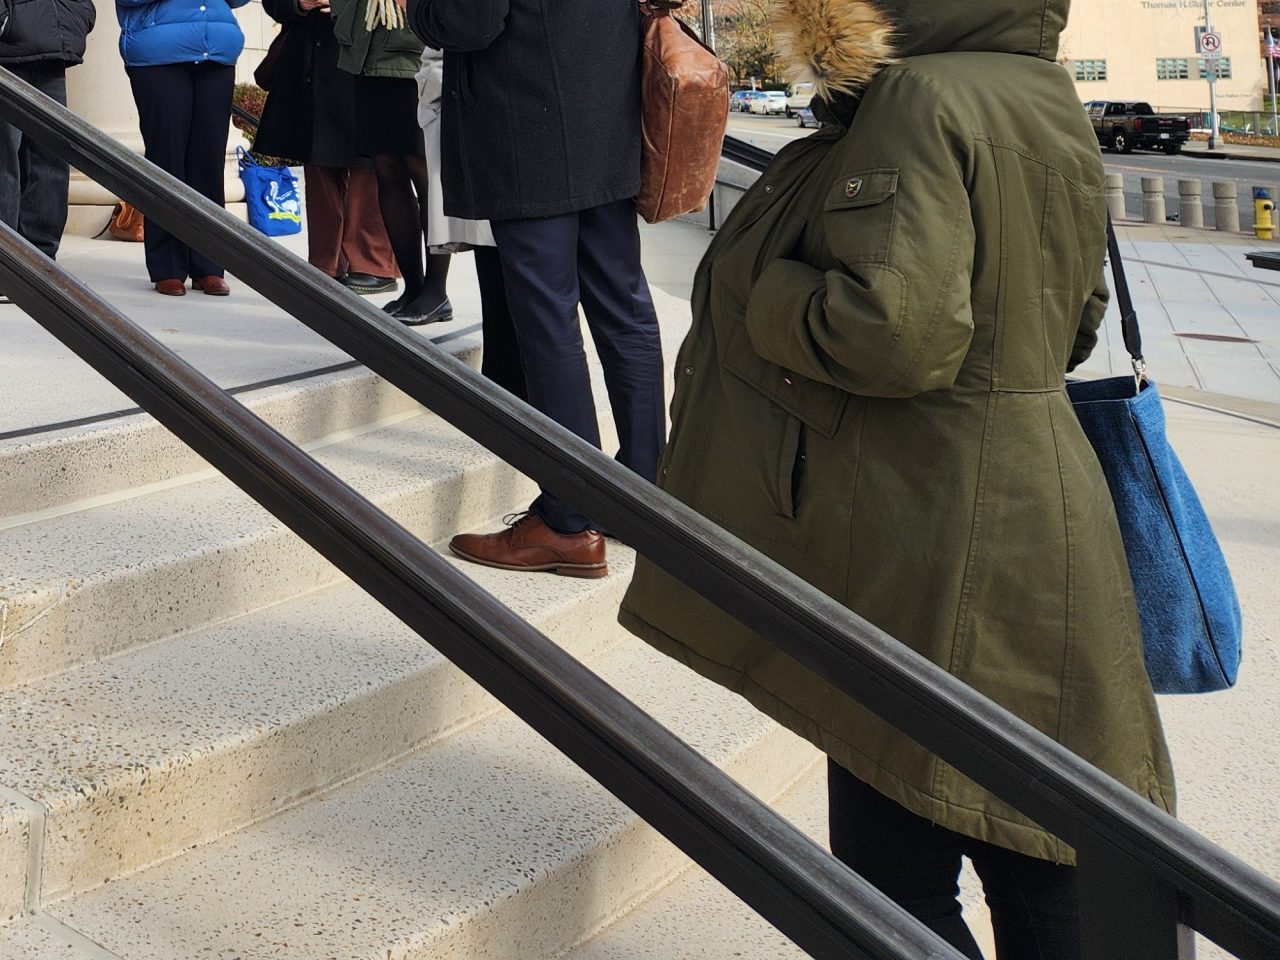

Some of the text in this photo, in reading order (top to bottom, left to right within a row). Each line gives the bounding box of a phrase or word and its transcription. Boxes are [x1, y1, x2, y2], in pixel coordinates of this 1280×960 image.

[1140, 1, 1177, 9] Thomas
[1189, 0, 1214, 8] Slar
[1216, 0, 1247, 8] Center
